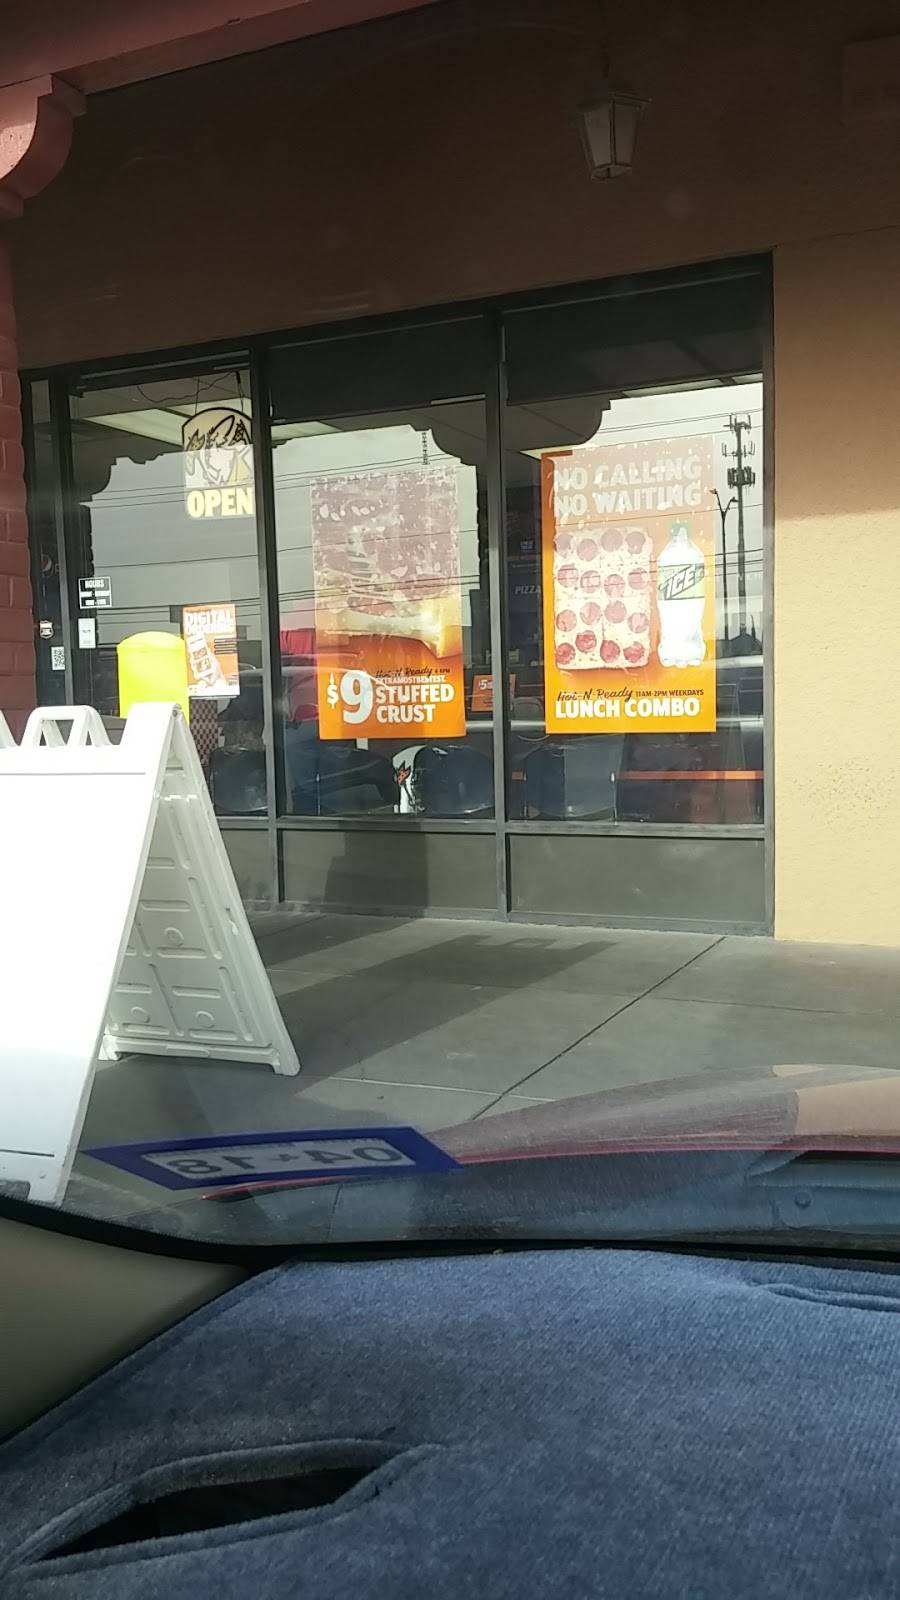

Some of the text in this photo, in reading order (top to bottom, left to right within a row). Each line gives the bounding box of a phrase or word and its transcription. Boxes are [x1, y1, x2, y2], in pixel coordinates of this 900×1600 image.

[554, 455, 702, 491] NO CALLING
[186, 487, 255, 518] OPEN
[554, 481, 702, 517] NO WAITING
[375, 683, 455, 704] STUFFED
[635, 690, 668, 698] 11AM-2PM
[669, 688, 705, 697] WEEKDAYS
[376, 704, 436, 724] CRUST
[555, 697, 700, 719] LUNCH COMBO
